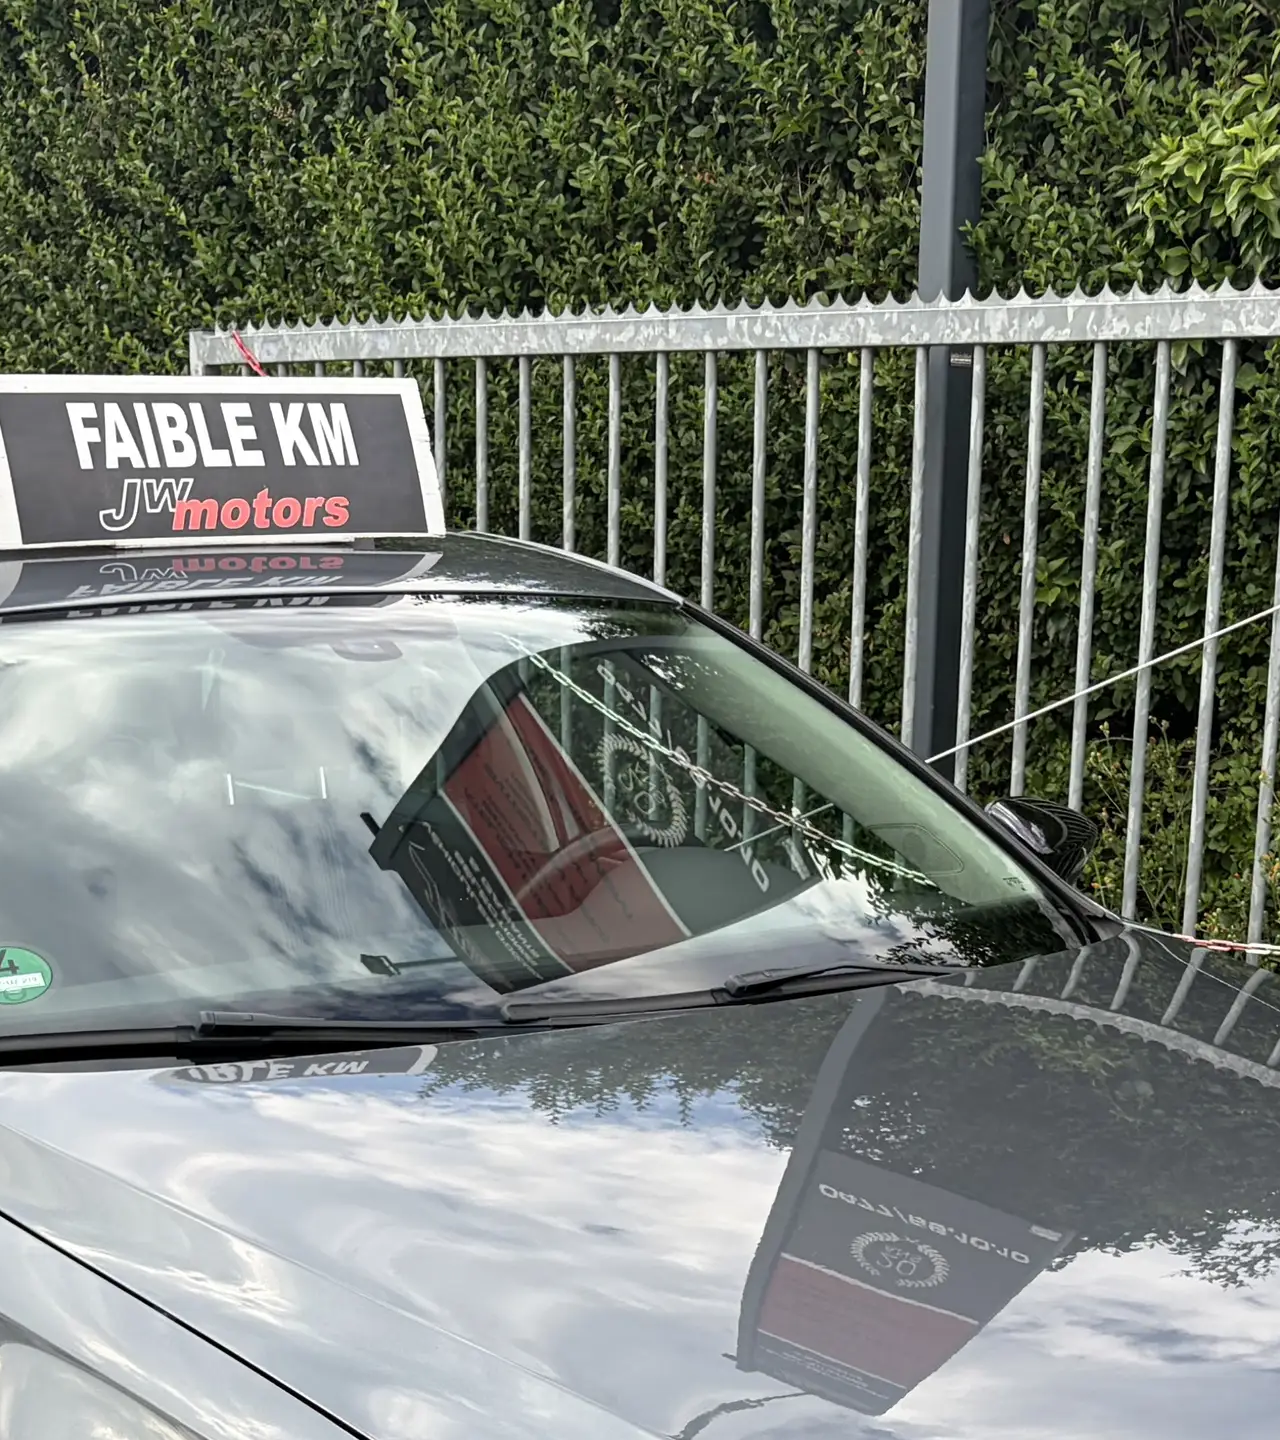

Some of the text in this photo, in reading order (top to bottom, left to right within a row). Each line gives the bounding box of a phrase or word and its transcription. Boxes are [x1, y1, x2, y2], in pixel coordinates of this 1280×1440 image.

[65, 402, 360, 470] FAIBLE KM
[99, 477, 350, 532] JW motors
